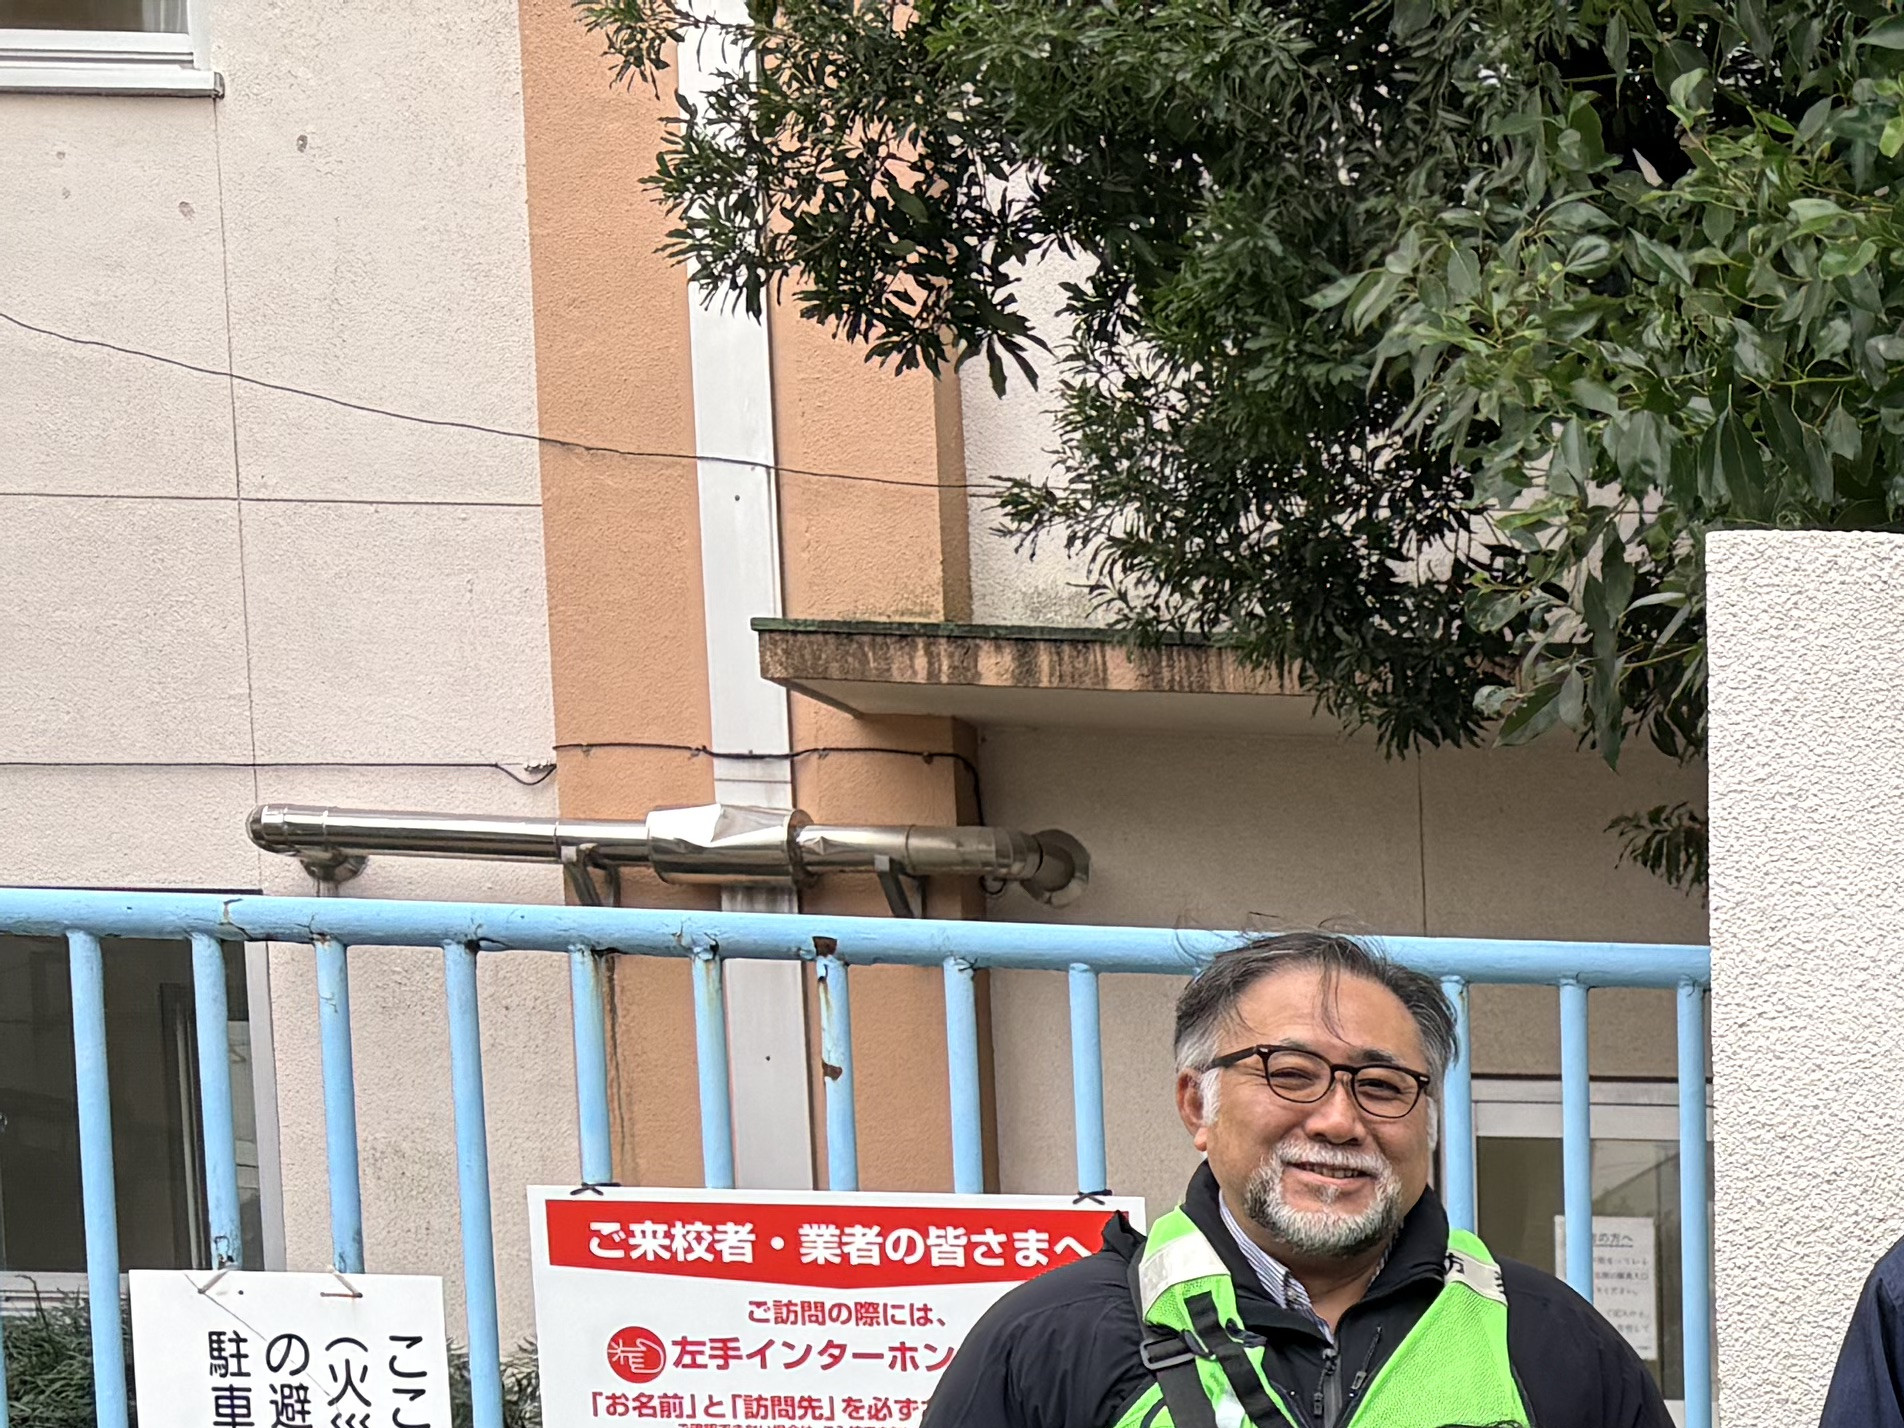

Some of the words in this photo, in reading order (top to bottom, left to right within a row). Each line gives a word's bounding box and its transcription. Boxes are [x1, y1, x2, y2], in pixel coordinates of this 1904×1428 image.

[588, 1220, 1093, 1267] ご来校者・業者の皆さまへ
[748, 1300, 946, 1327] ご訪問の際には、
[672, 1337, 955, 1372] 左手インターホン
[591, 1392, 928, 1421] 「お名前」と「訪問先」を必ず
